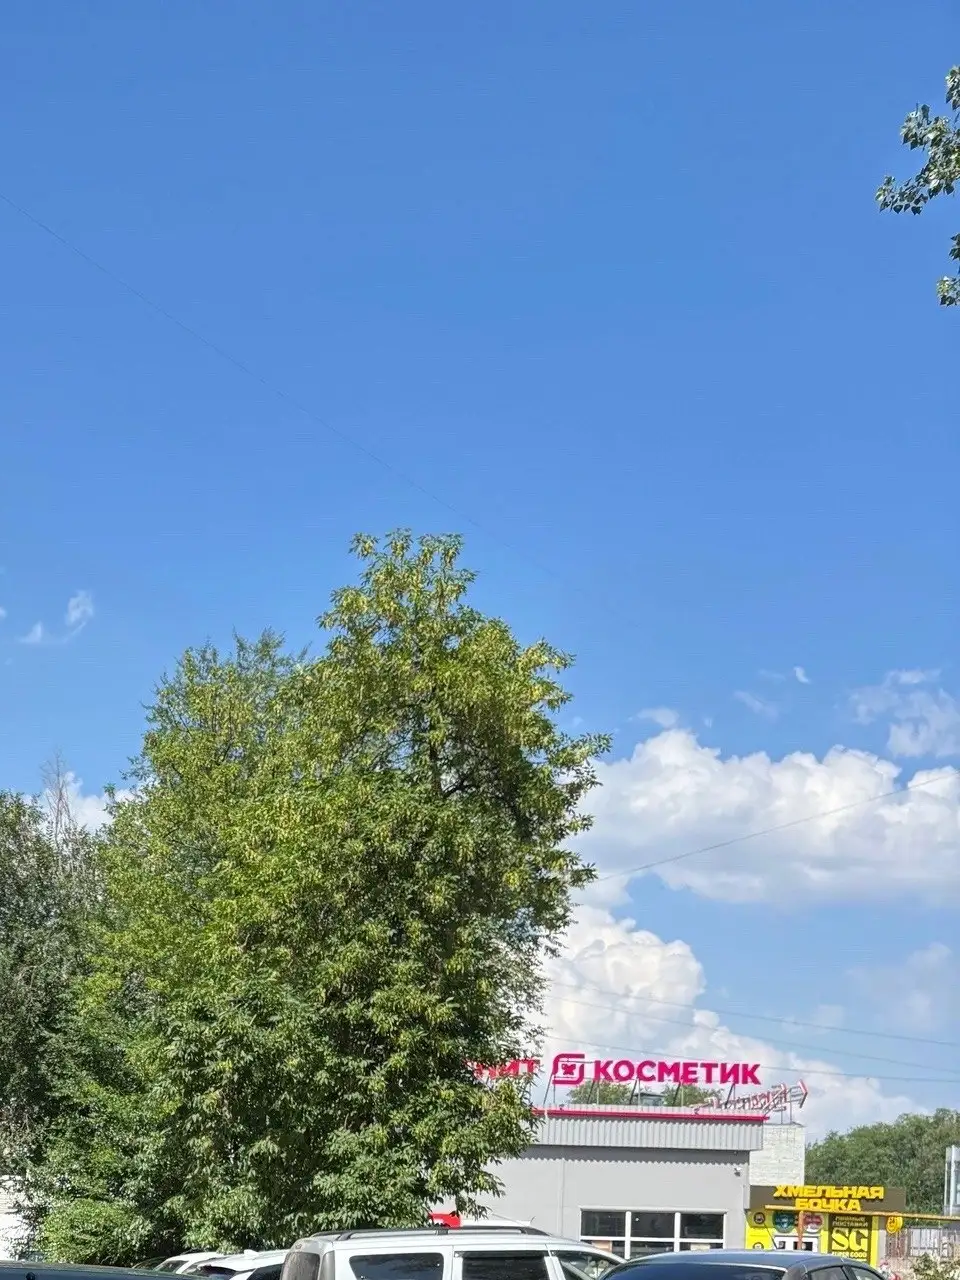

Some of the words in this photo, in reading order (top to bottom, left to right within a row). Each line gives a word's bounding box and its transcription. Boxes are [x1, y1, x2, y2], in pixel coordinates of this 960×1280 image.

[594, 1059, 761, 1085] КОСМЕТИК
[773, 1185, 884, 1200] ХМЕЛЬНАЯ
[795, 1198, 862, 1211] БОЧКА
[831, 1227, 869, 1251] SG
